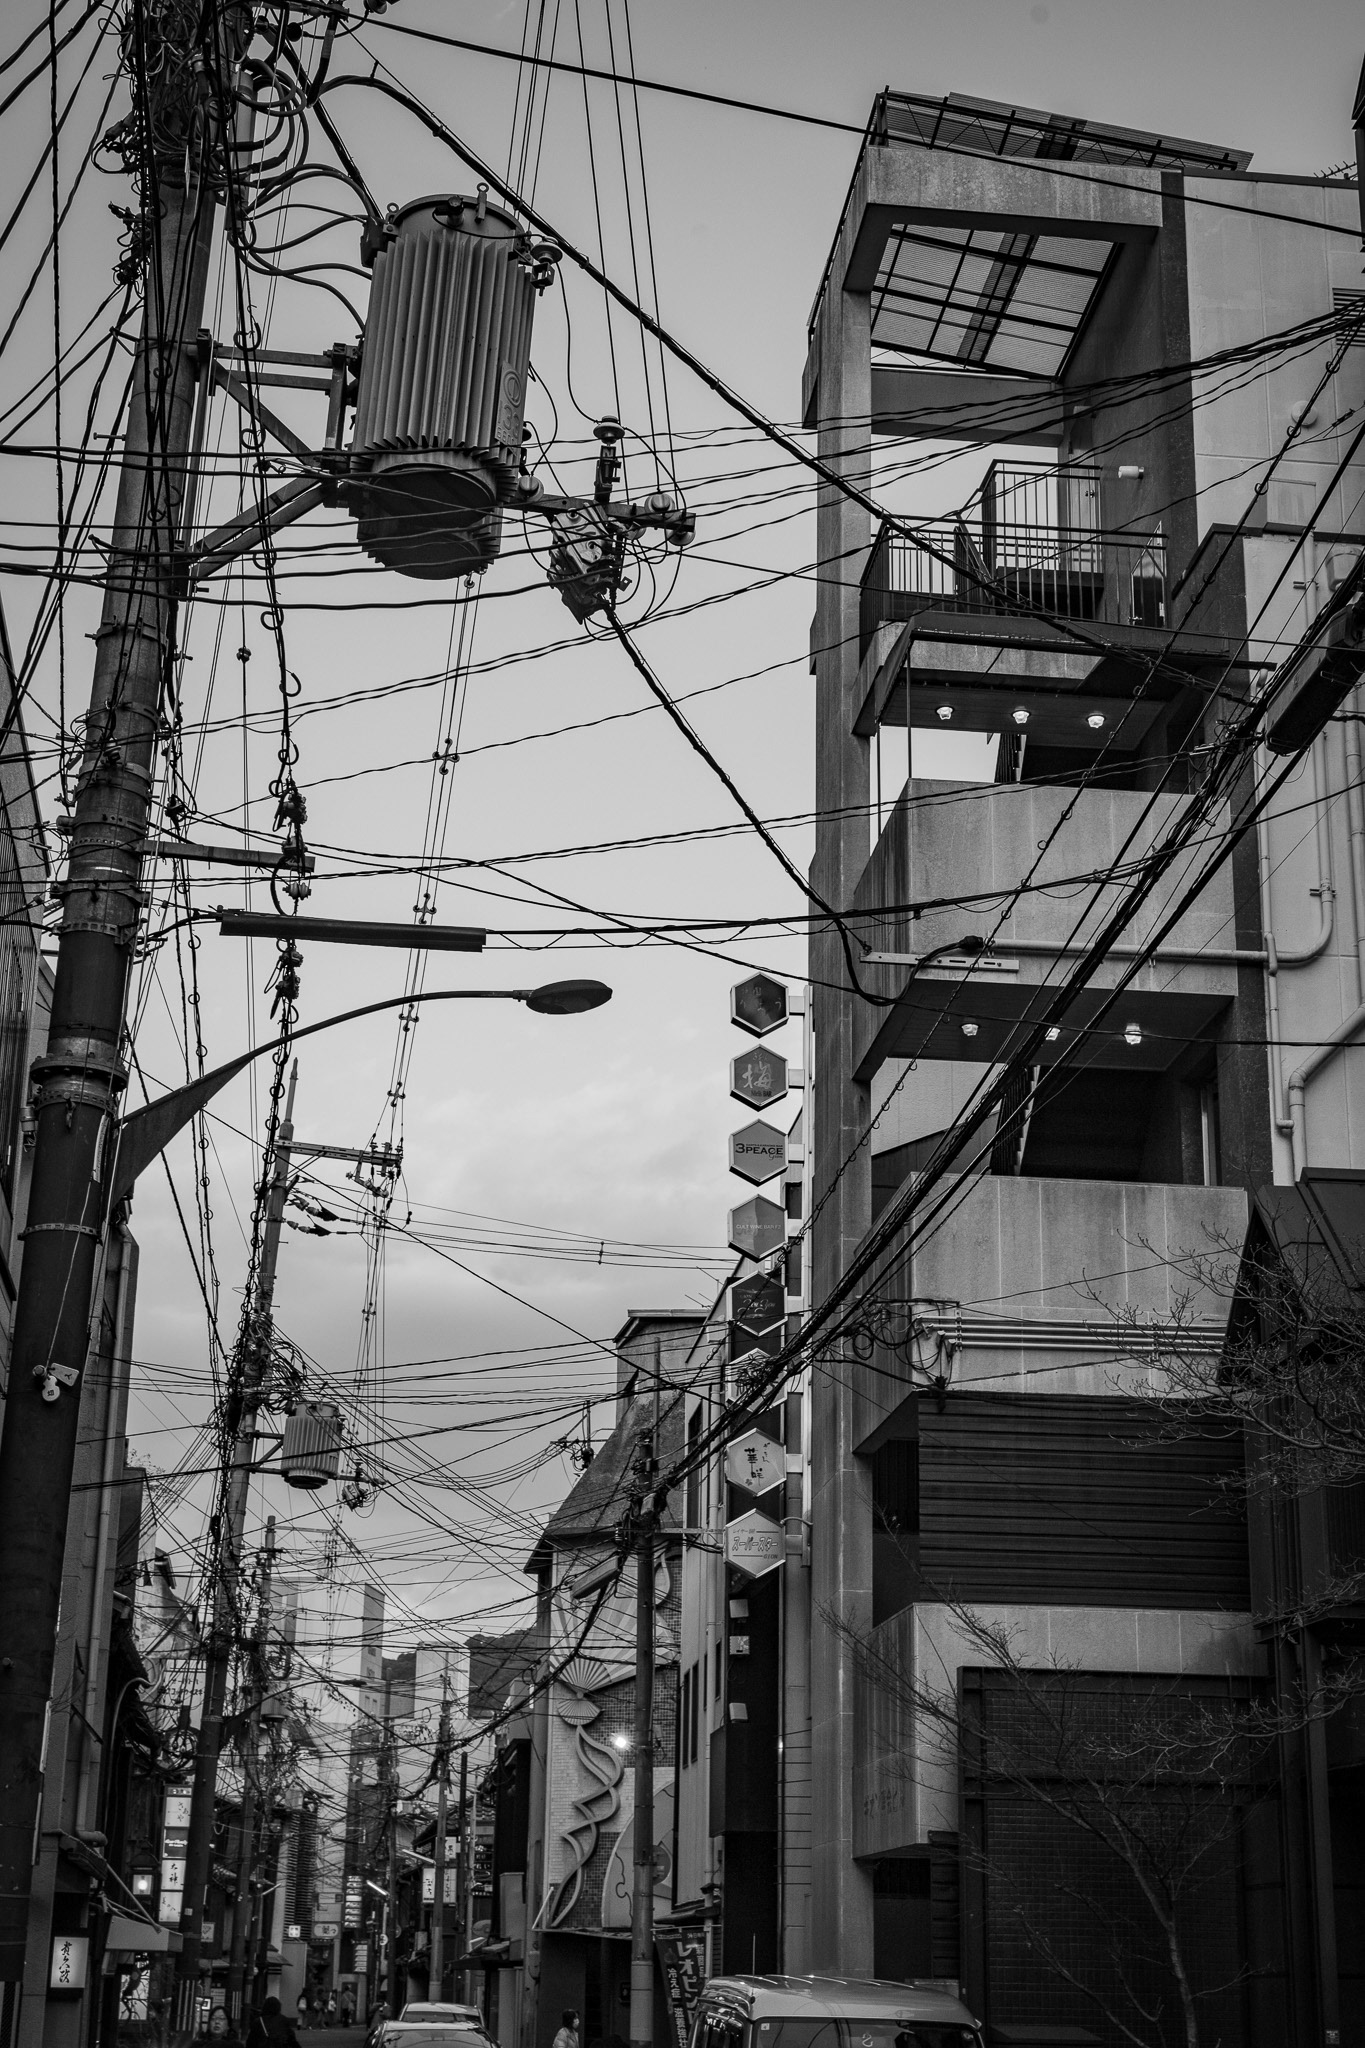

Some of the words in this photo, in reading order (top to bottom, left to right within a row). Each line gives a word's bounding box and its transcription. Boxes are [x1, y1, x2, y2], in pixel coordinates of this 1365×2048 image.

[732, 1536, 778, 1552] スーパースター
